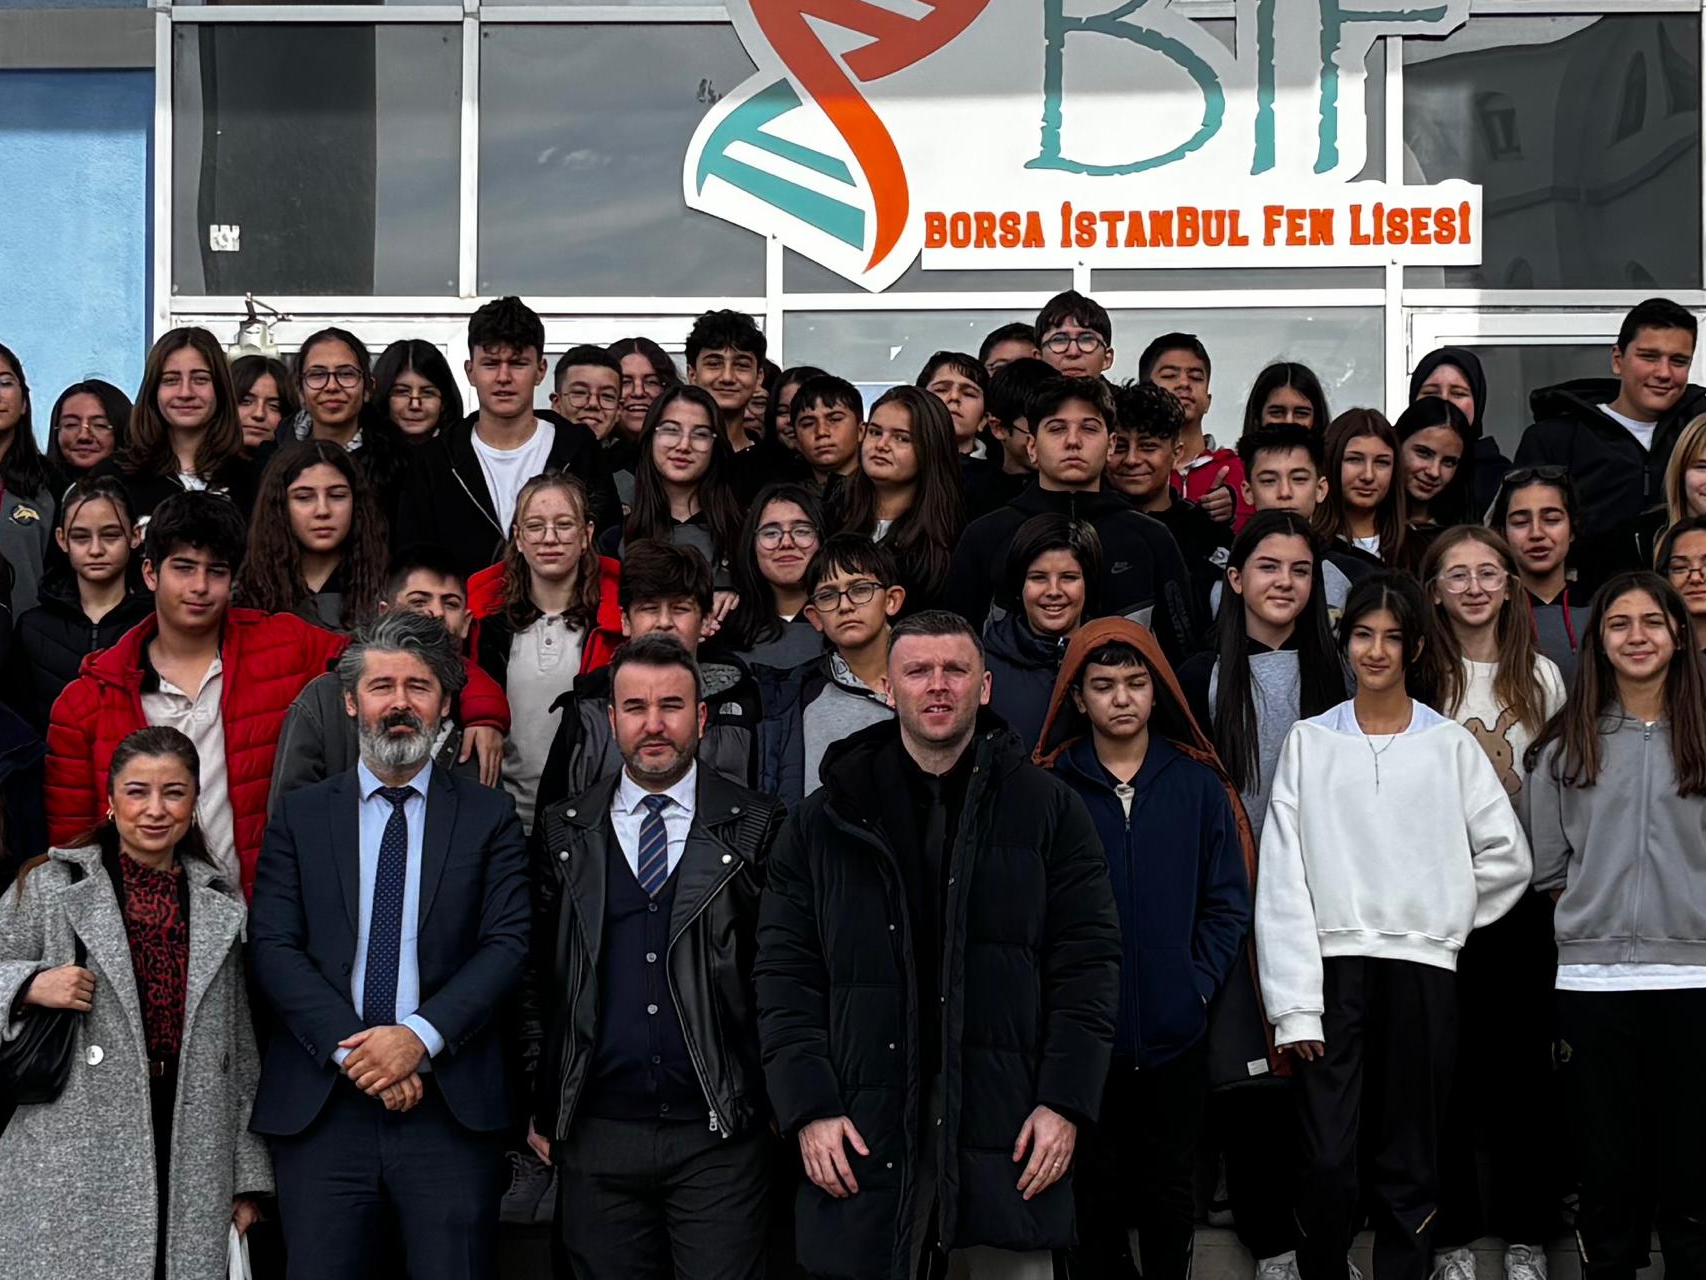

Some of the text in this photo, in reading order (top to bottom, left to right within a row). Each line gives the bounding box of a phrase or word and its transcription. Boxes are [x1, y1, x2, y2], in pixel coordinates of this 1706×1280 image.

[924, 201, 1472, 249] BORSA İSTANBUL FEN LİSESİ
